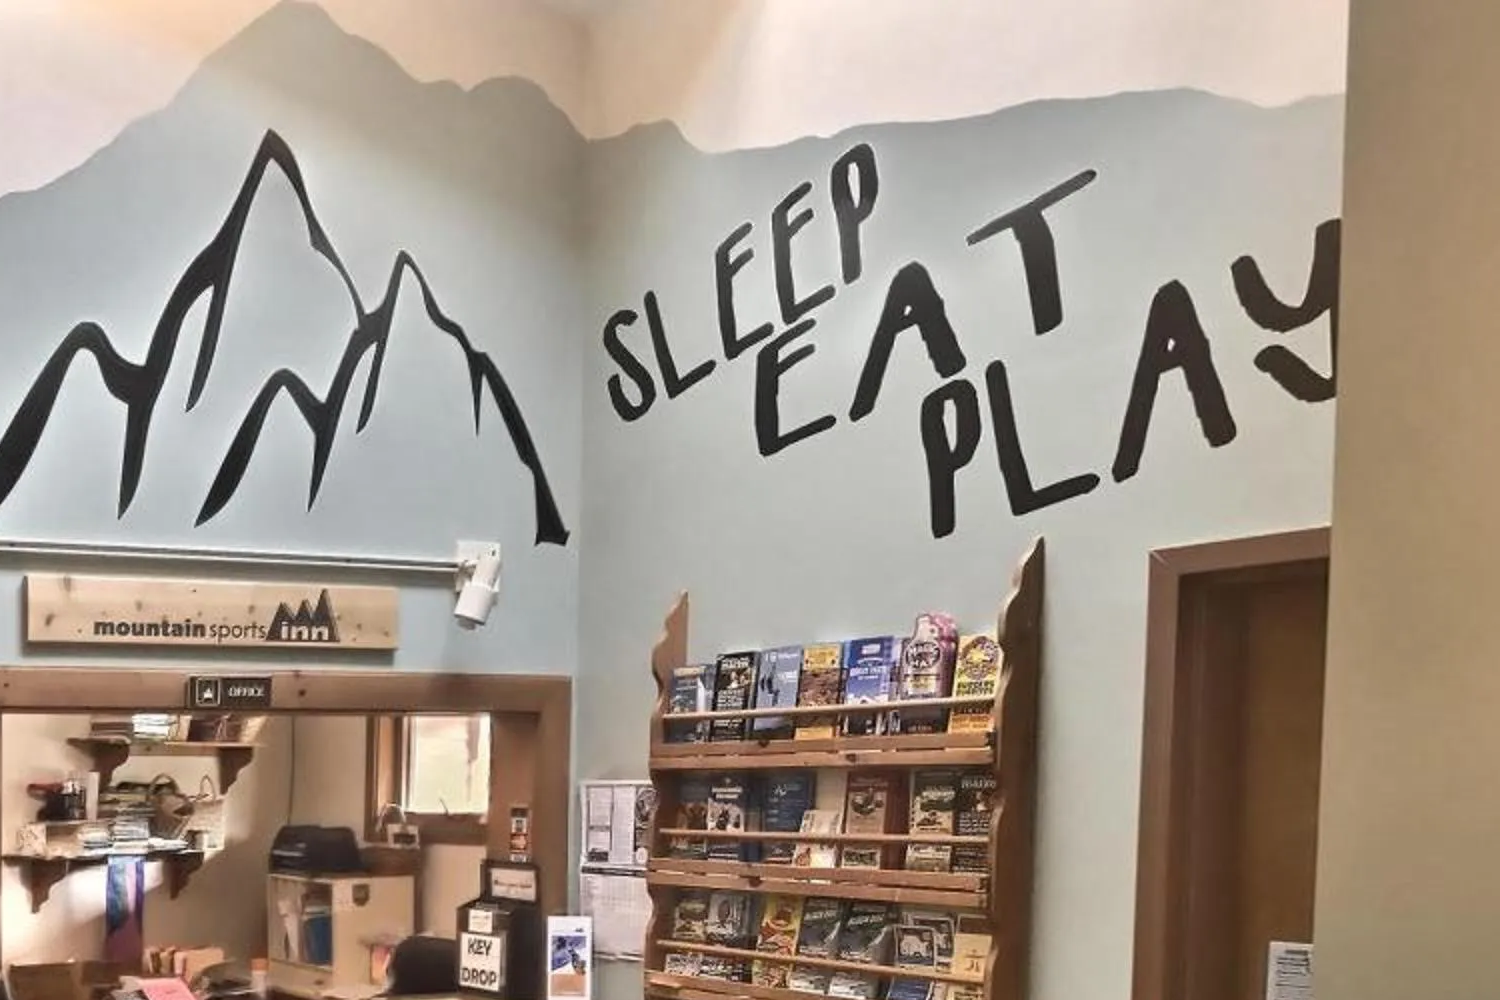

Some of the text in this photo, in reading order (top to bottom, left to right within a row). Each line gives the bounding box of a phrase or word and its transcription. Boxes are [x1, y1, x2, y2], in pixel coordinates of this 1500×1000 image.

[602, 144, 879, 421] SLEEP
[755, 169, 1097, 457] EAT
[920, 218, 1342, 538] PLAY
[93, 618, 330, 645] mountain sports inn
[227, 686, 265, 698] OFFICE
[467, 937, 493, 957] KEY
[461, 967, 497, 986] DROP
